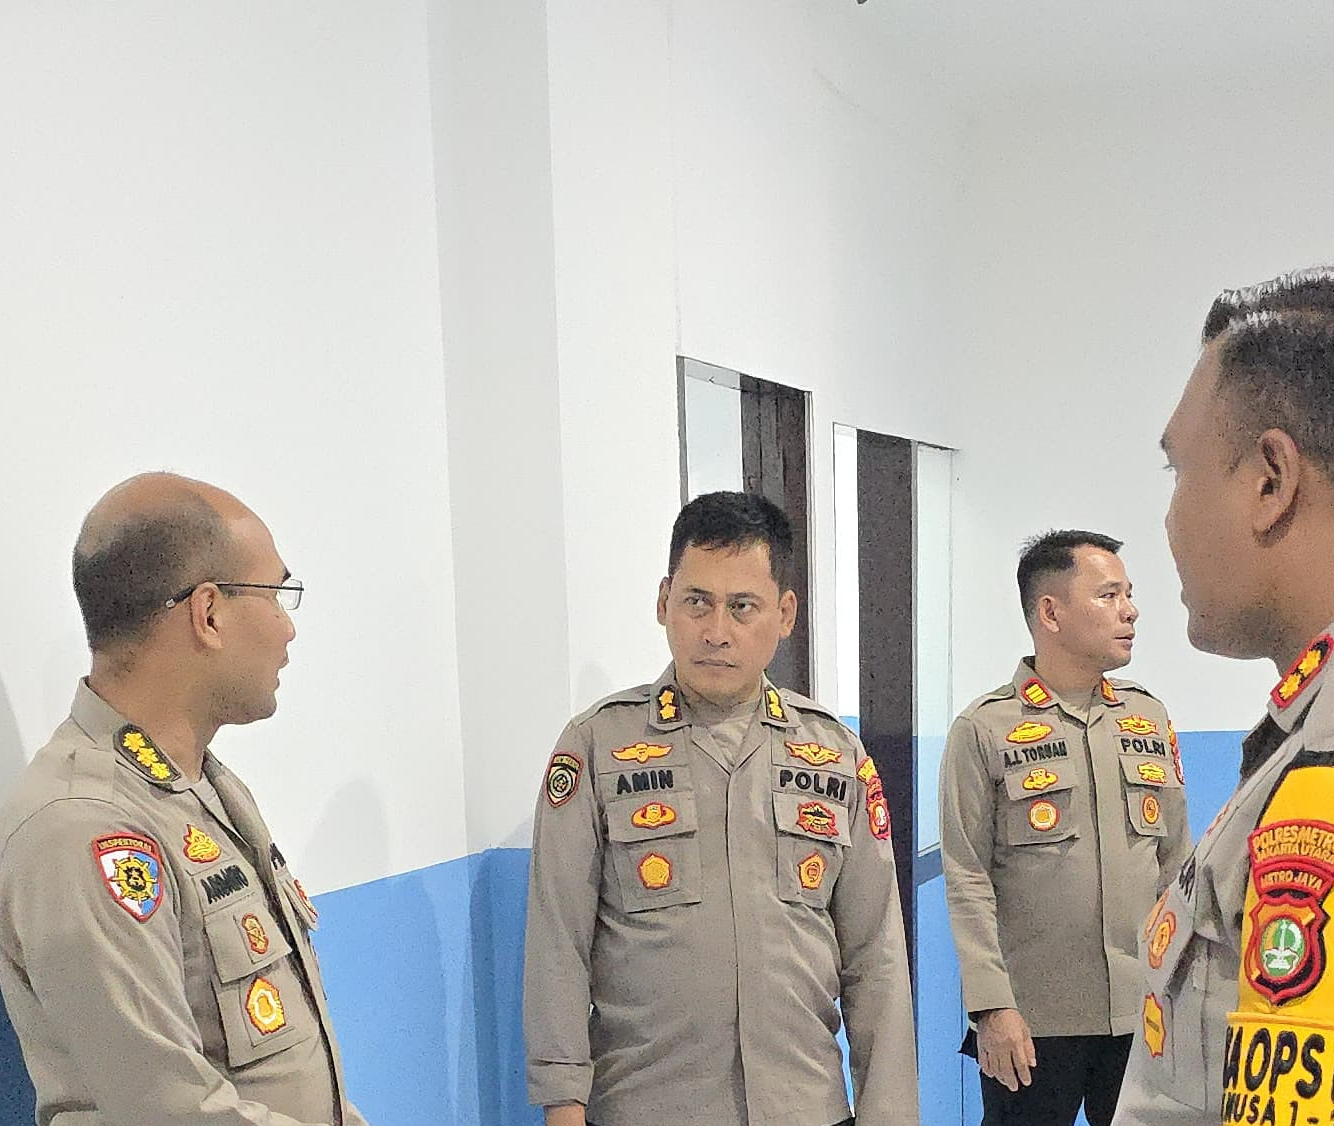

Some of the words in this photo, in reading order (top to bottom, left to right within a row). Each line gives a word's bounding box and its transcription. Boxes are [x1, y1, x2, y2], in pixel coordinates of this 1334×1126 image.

[1121, 738, 1166, 757] POLRI
[616, 769, 674, 795] AMIN
[779, 769, 847, 801] POLRI
[1252, 825, 1299, 849] POLRES
[1254, 842, 1300, 864] JAKARTA
[1260, 869, 1294, 889] METRO
[1294, 871, 1324, 891] JAYA
